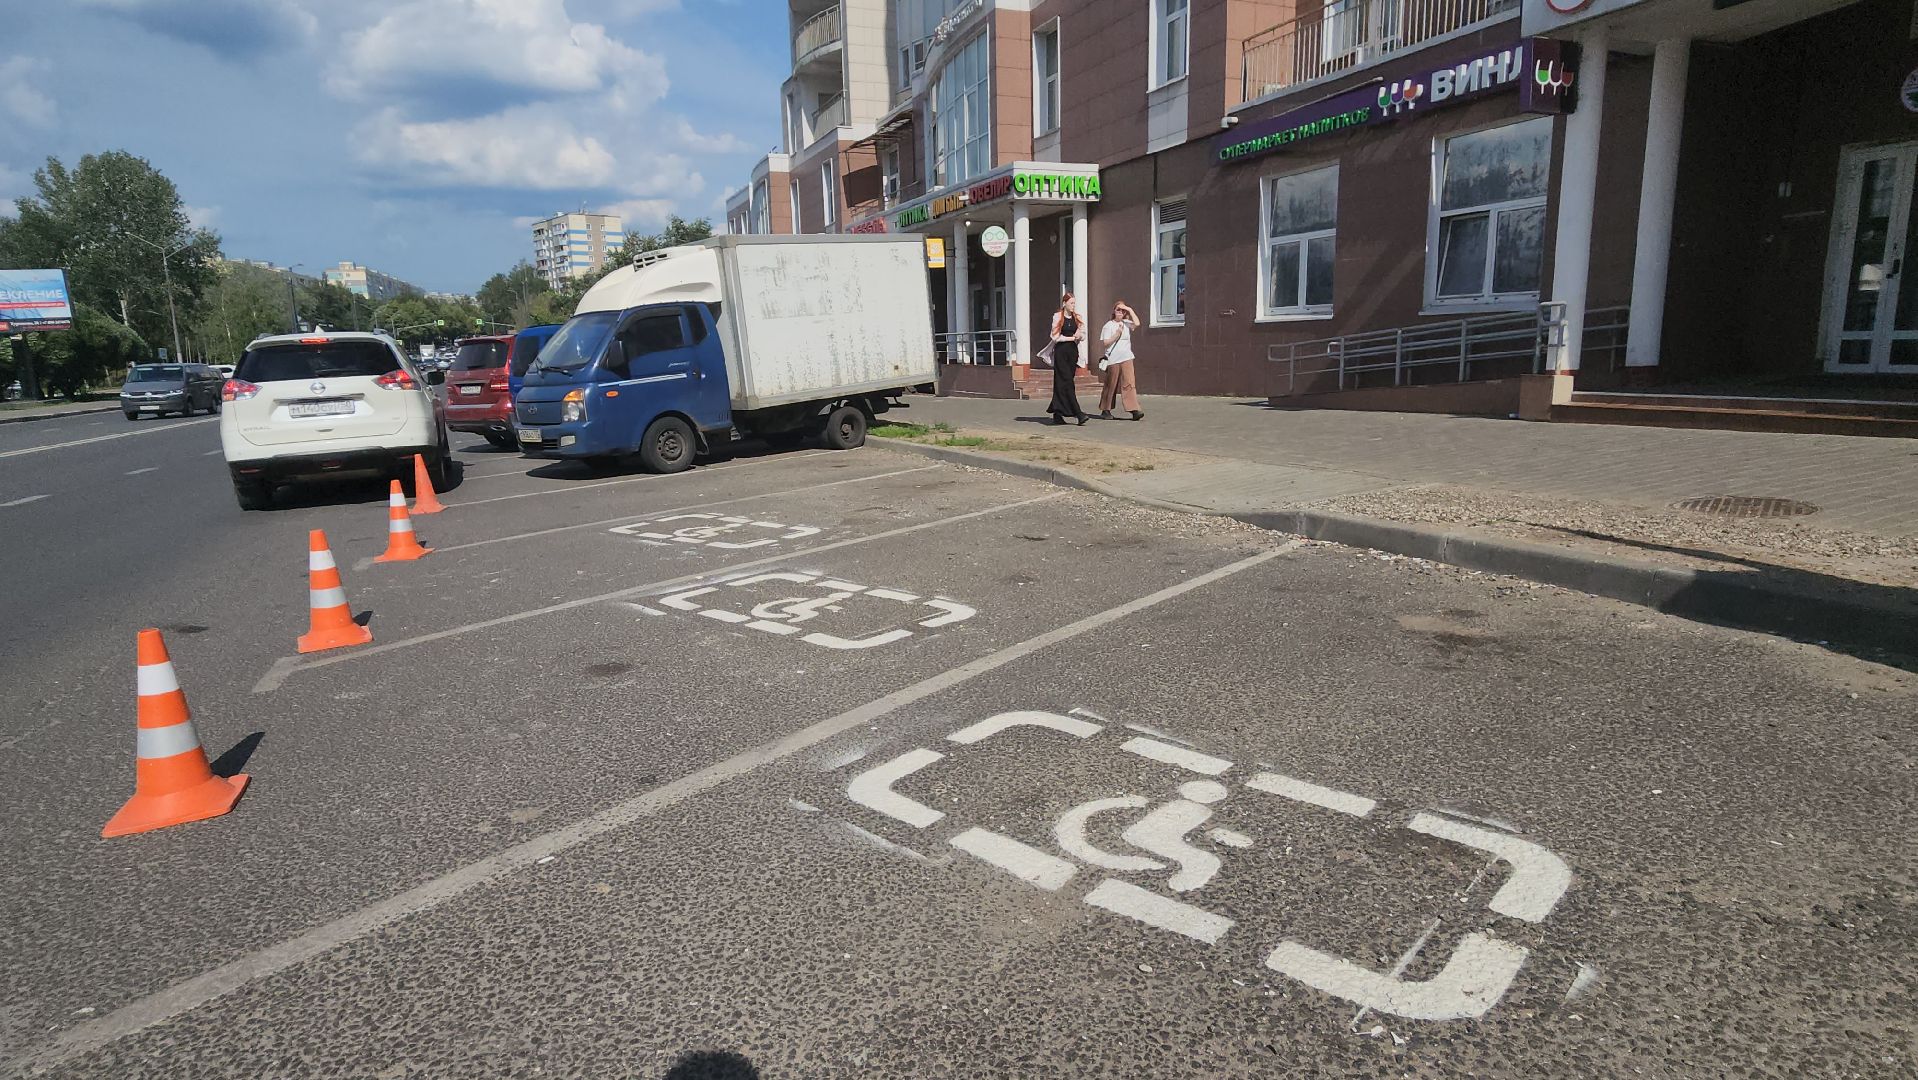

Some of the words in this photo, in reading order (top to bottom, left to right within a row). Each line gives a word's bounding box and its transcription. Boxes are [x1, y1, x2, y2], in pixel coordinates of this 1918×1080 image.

[1219, 127, 1298, 160] СУПЕРМАРКЕТ
[1298, 106, 1370, 140] НАПИТКОВ
[969, 175, 1011, 205] ЮВЕЛИР
[1014, 173, 1102, 195] ОПТИКА
[897, 204, 928, 227] ОПТИКА
